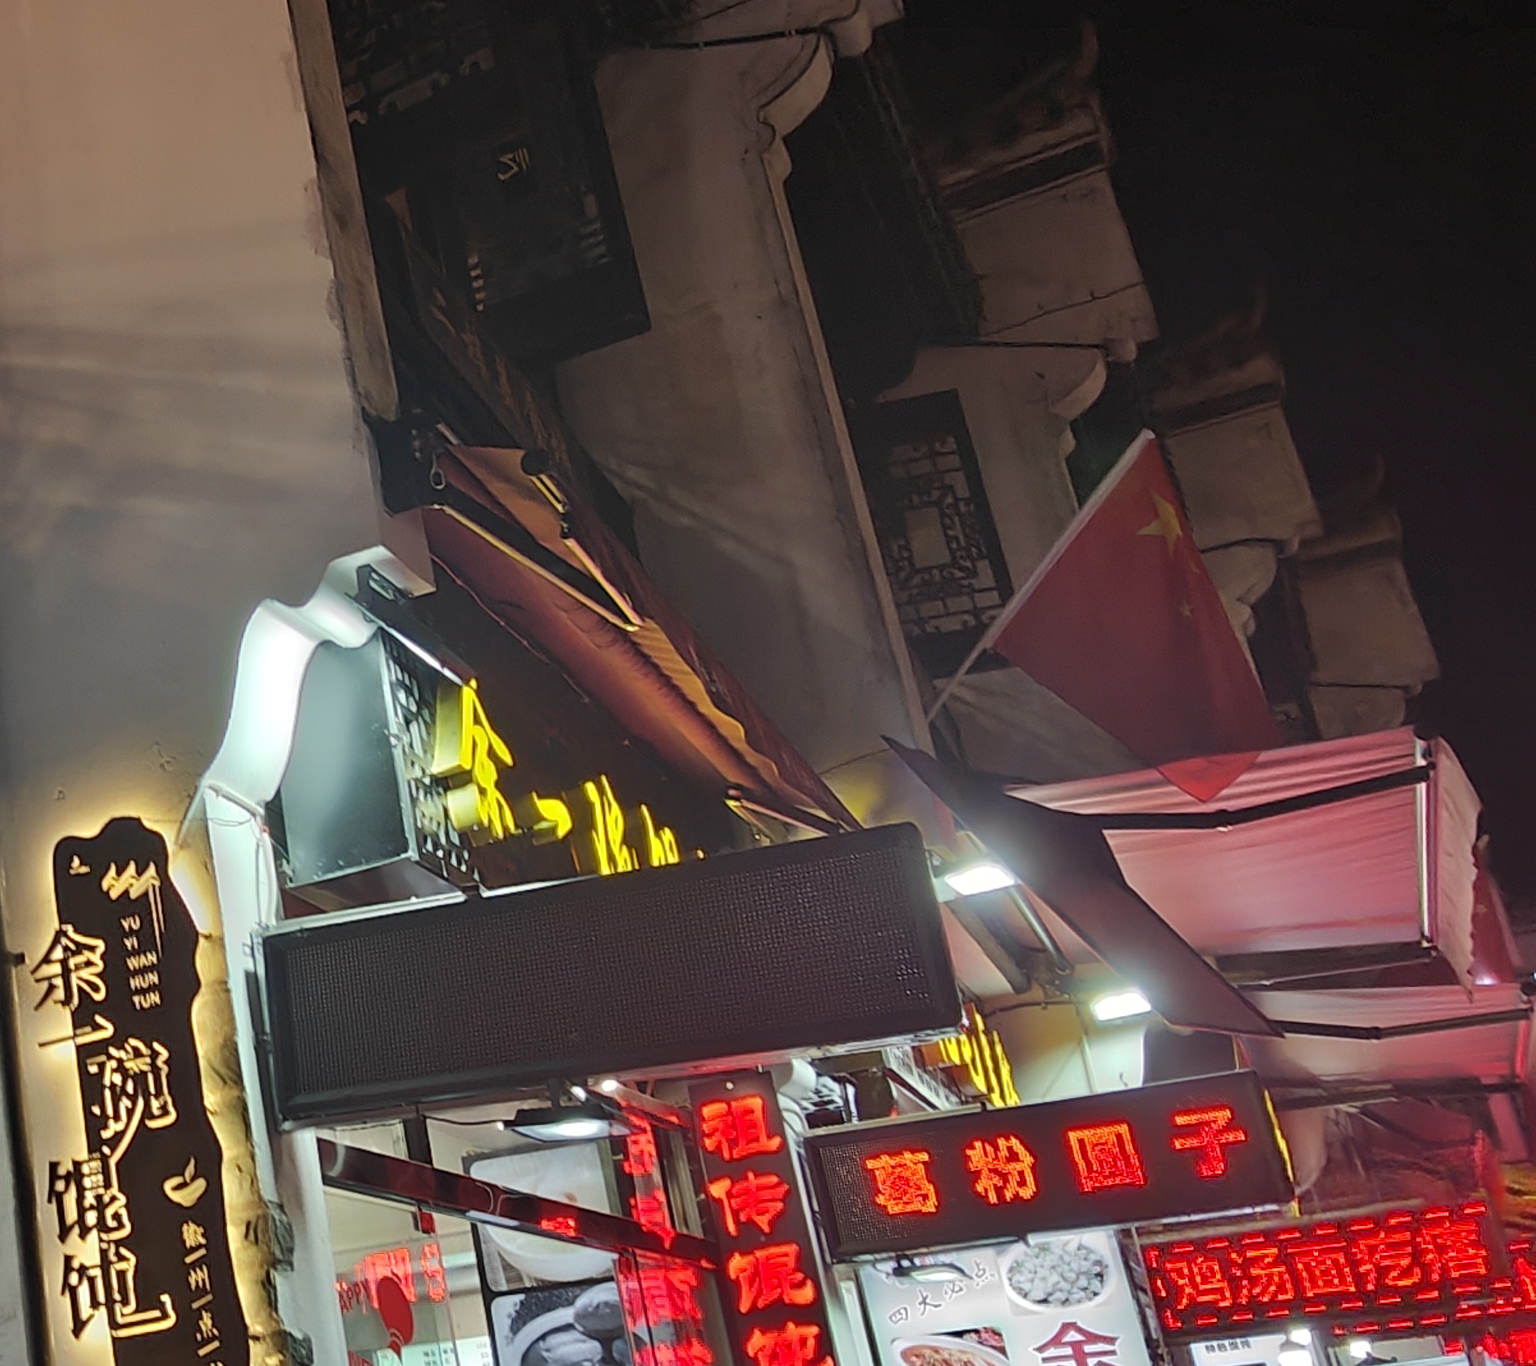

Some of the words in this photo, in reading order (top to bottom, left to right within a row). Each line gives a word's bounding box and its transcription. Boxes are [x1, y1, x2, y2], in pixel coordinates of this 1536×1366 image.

[120, 914, 141, 933] YU
[123, 934, 139, 951] YI
[125, 950, 158, 972] WAN
[129, 970, 159, 992] HUN
[132, 990, 161, 1011] TUN
